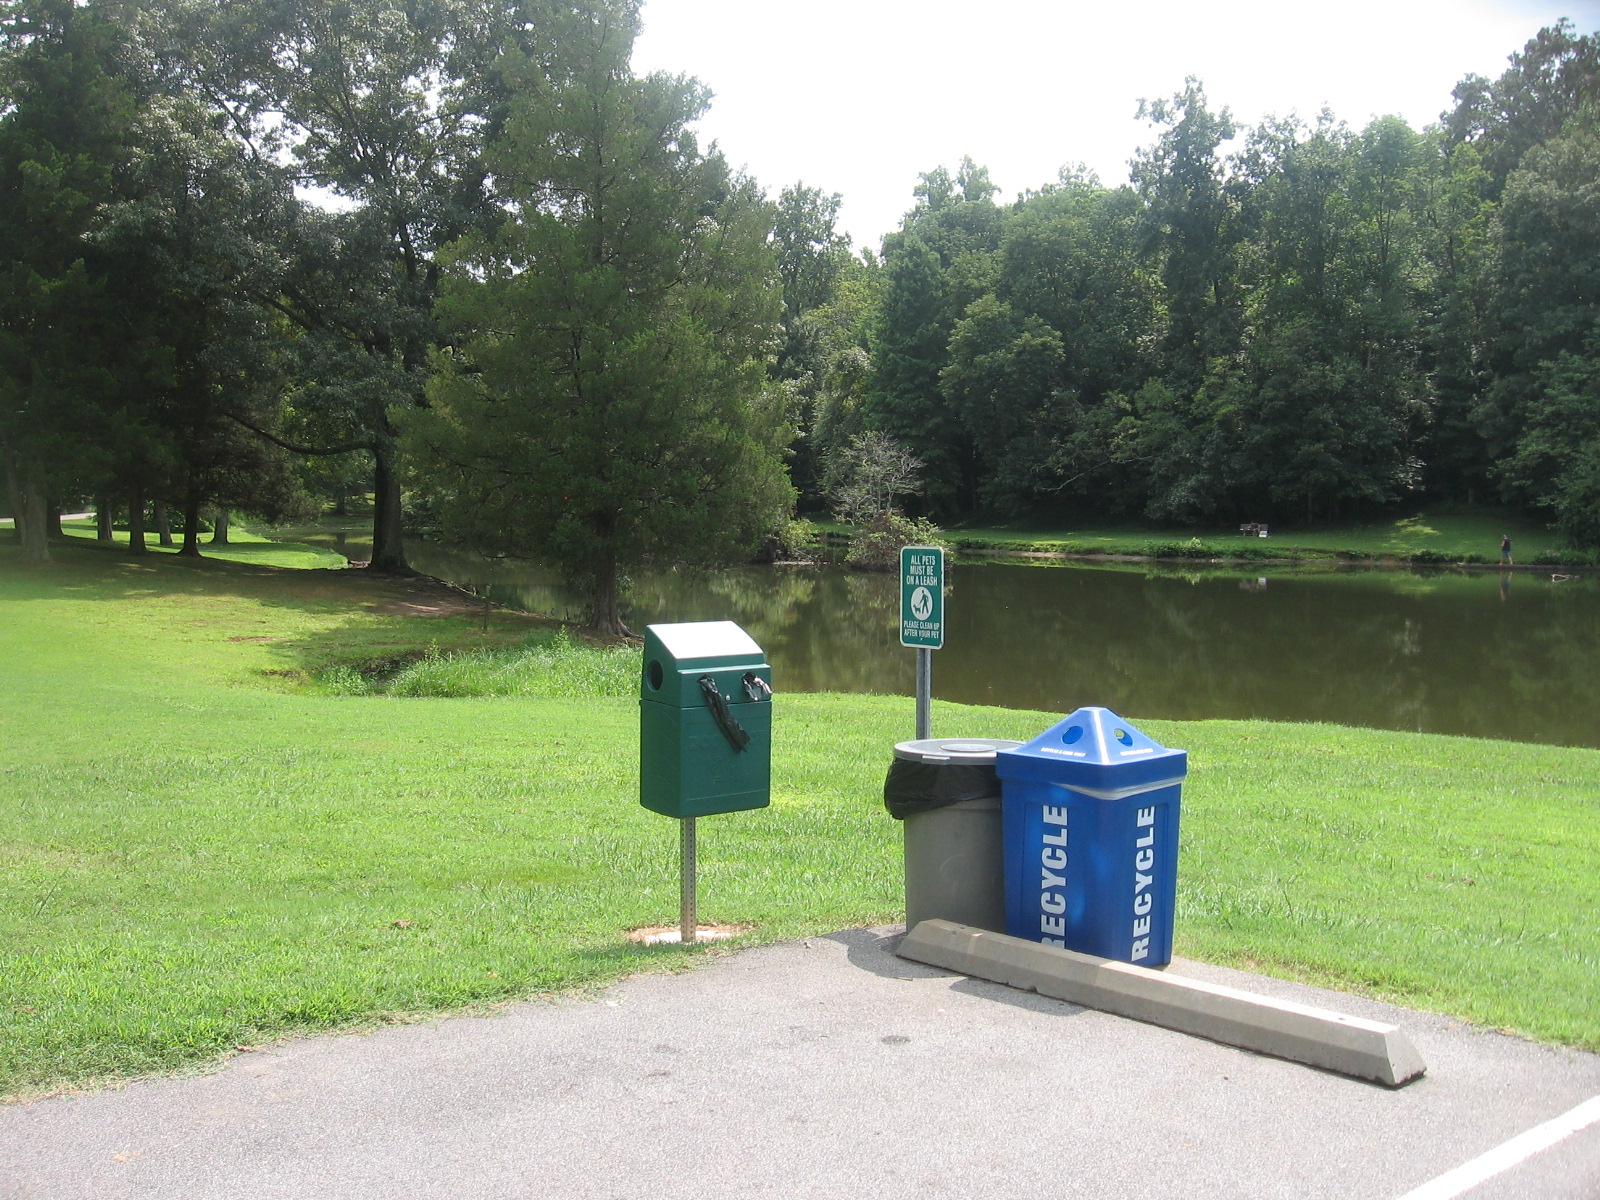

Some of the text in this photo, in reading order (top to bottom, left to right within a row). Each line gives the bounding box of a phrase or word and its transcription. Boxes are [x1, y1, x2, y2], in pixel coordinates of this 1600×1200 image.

[911, 555, 936, 566] ALL PETS
[910, 565, 934, 575] MUST BE
[906, 575, 938, 586] ON A LEASH
[903, 620, 940, 631] PLEASE CLEAN UP
[904, 628, 918, 637] AFTER
[931, 630, 939, 639] PET
[1131, 806, 1156, 962] RECYCLE
